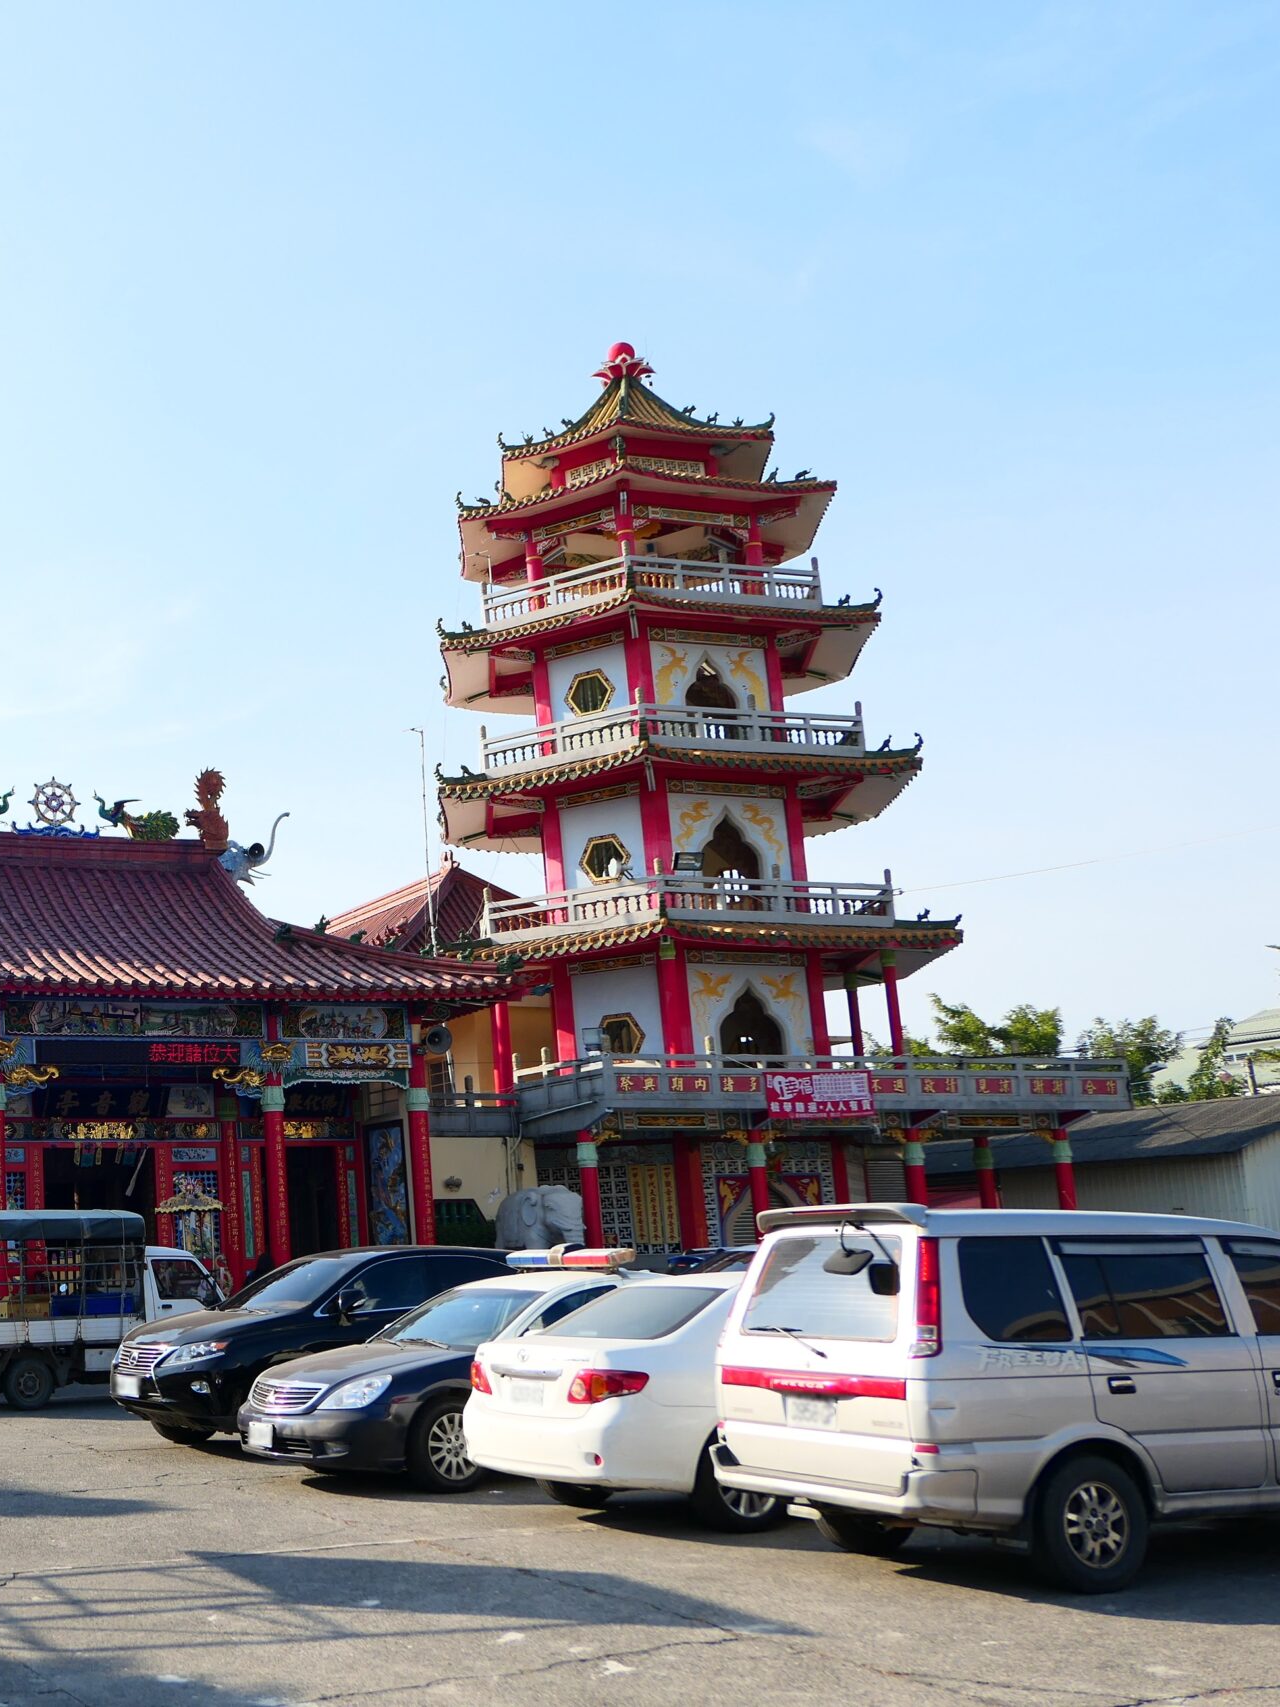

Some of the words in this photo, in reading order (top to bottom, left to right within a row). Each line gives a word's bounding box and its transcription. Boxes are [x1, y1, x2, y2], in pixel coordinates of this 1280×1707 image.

[148, 1043, 239, 1063] 恭迎諸位大
[56, 1089, 151, 1116] 觀音亭
